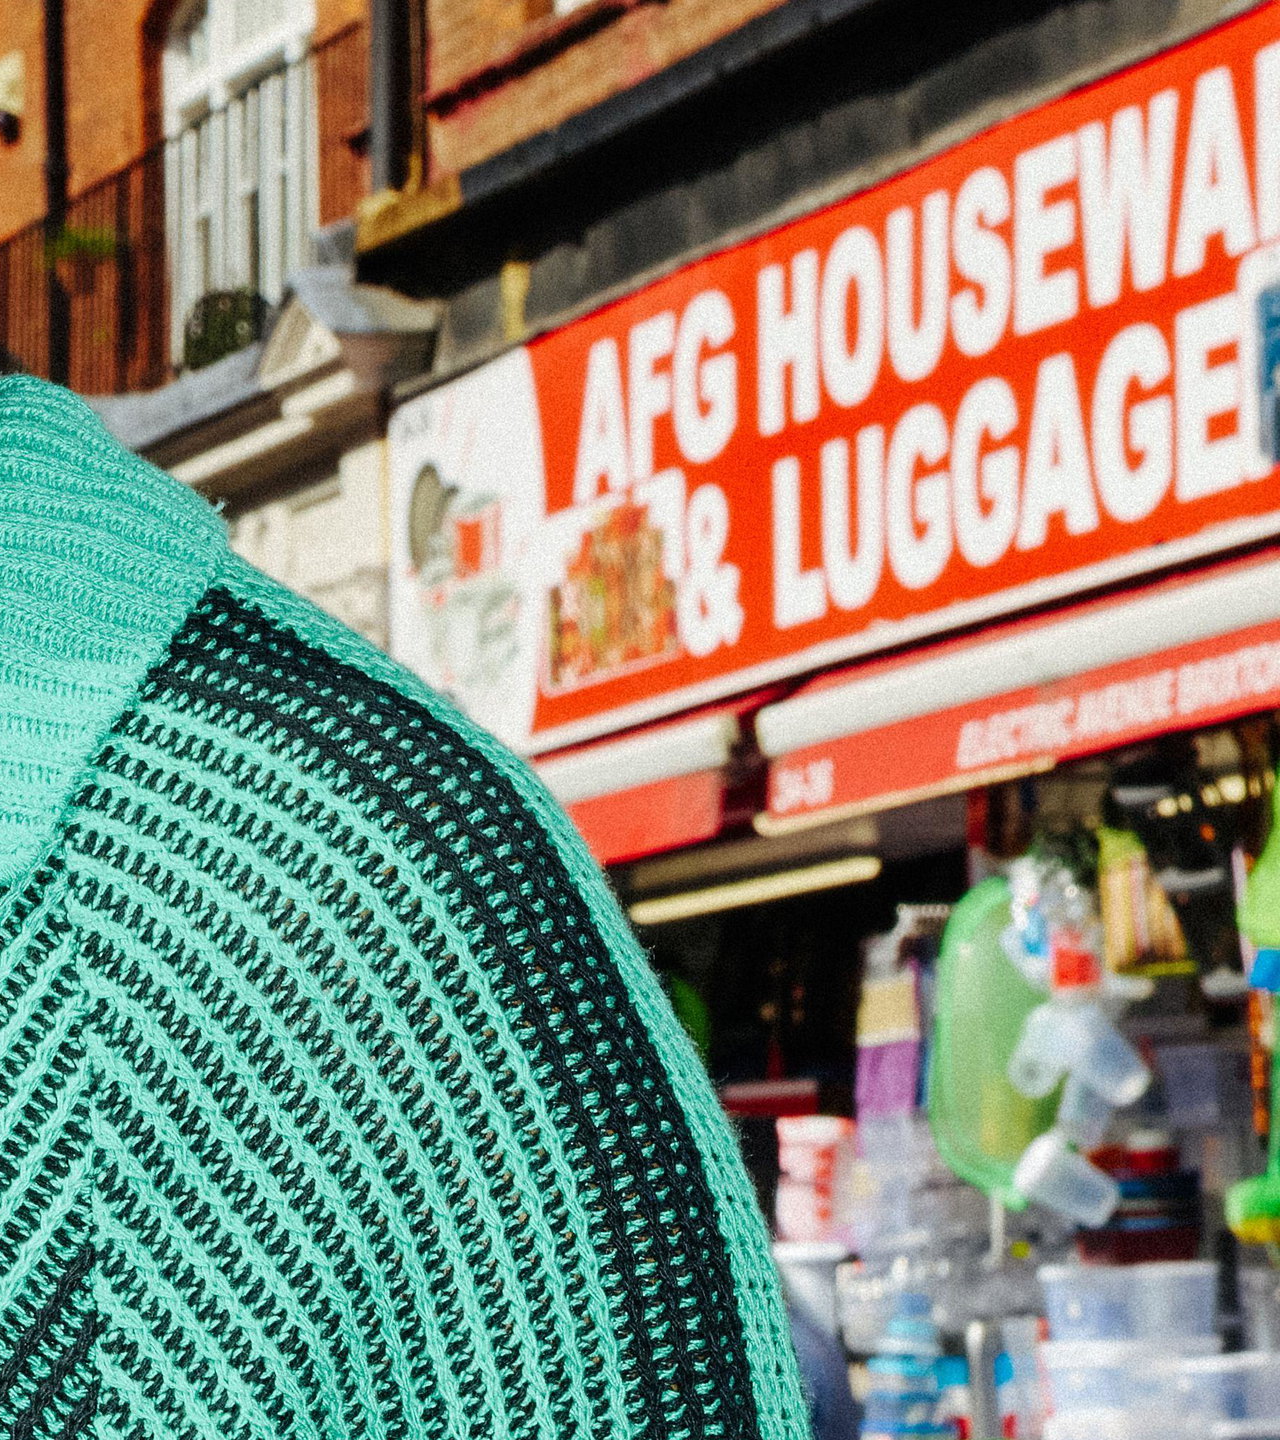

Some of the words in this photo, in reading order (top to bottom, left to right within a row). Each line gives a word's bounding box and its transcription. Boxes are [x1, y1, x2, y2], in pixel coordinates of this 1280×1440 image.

[572, 288, 738, 505] AFG
[677, 482, 744, 659] &
[771, 290, 1241, 630] LUGGAGE
